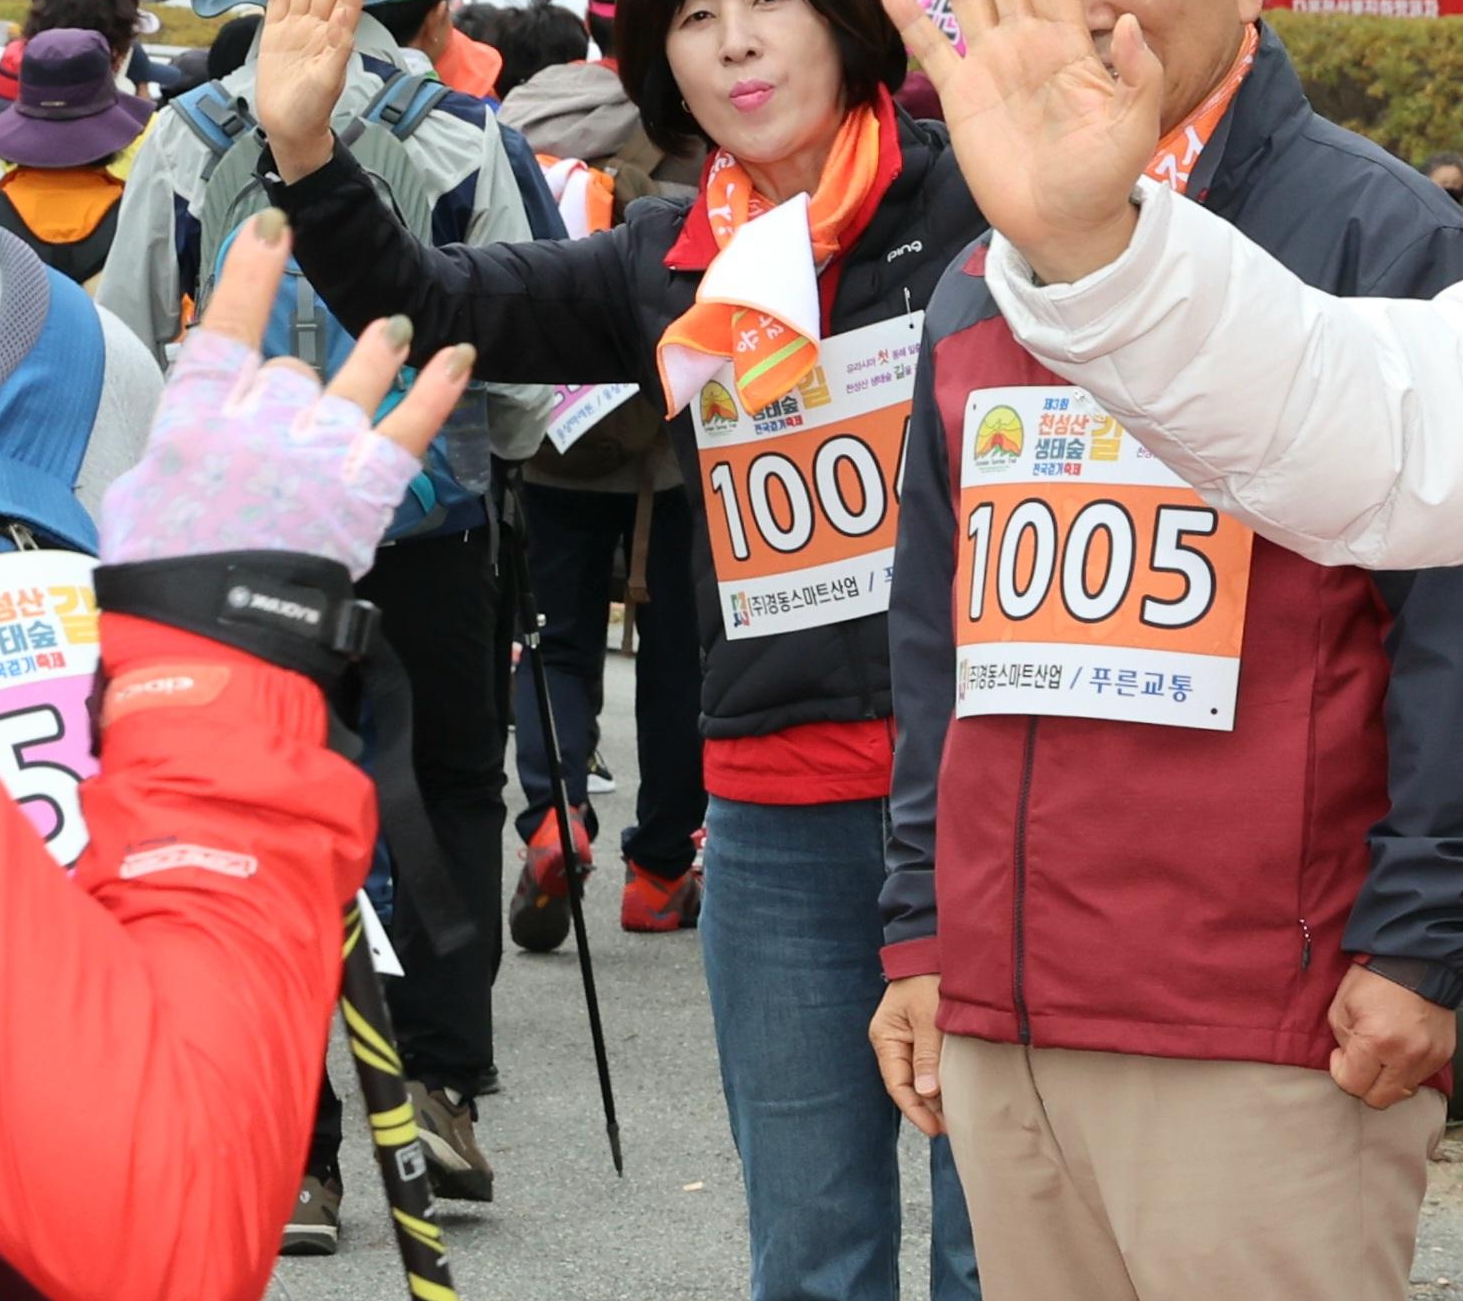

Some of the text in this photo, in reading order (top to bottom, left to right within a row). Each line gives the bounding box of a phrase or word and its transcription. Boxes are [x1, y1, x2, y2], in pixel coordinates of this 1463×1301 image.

[1038, 413, 1090, 436] 천성산
[1034, 438, 1085, 460] 생태숲
[710, 415, 911, 561] 100
[968, 497, 1219, 630] 1005
[48, 585, 100, 645] 길
[1089, 667, 1194, 703] 푸른교통
